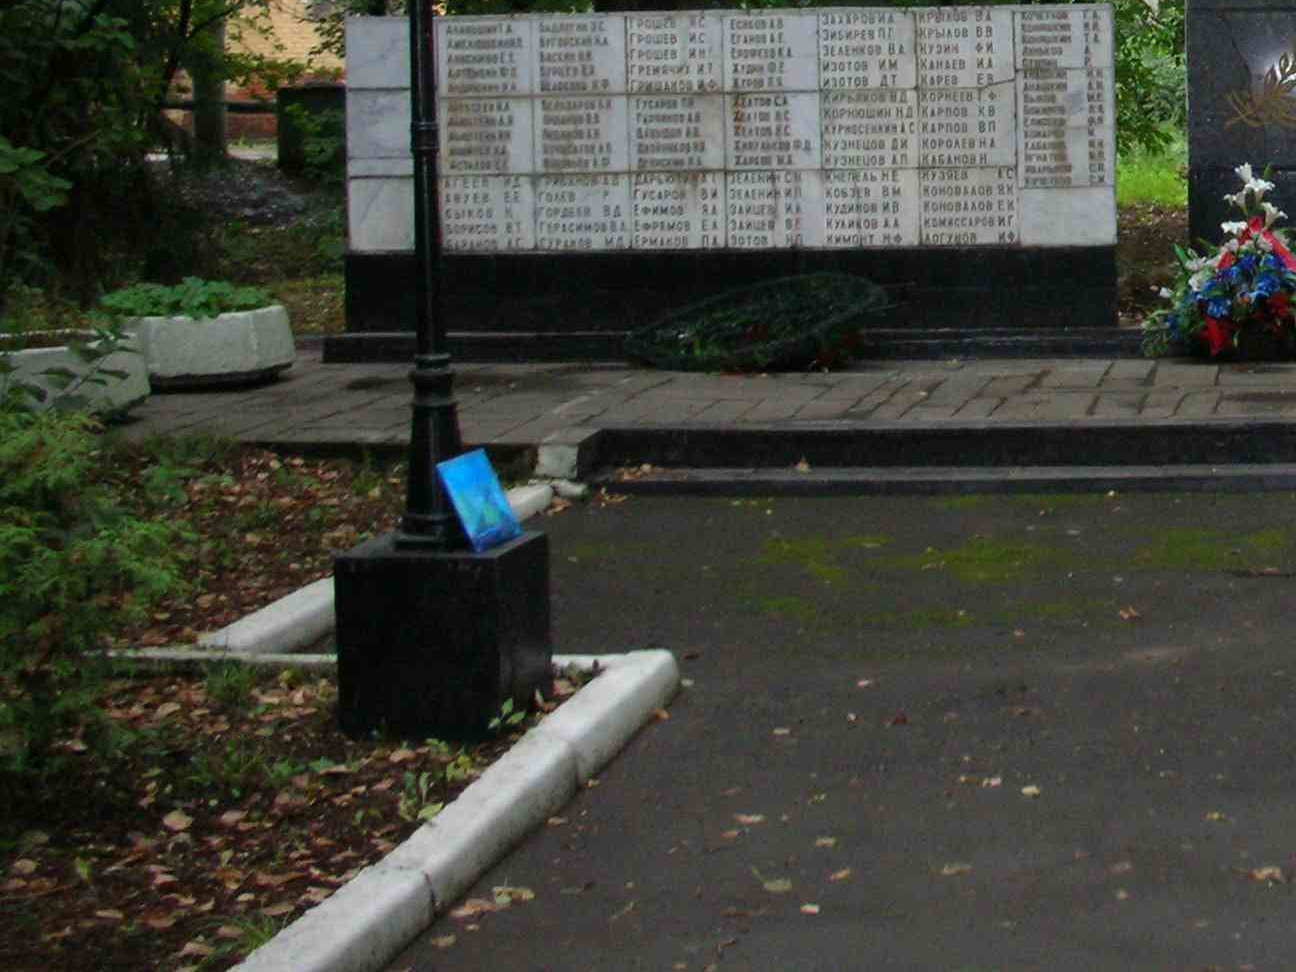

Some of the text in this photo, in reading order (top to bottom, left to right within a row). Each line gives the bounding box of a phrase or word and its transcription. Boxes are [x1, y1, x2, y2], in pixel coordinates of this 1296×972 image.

[630, 33, 677, 44] ГРОШЕВ
[919, 27, 969, 39] КРЫЛОВ
[630, 48, 678, 60] ГРОШЕВ
[823, 60, 869, 72] ИЗОТОВ
[919, 58, 967, 70] КАНАЕВ
[823, 76, 870, 88] ИЗОТОВ
[919, 74, 959, 86] КАРЕВ
[921, 107, 969, 119] КАРПОВ
[921, 123, 969, 135] КАРПОВ
[824, 139, 886, 151] КУЗНЕЦОВ
[921, 138, 976, 150] КОРОЛЕВ
[824, 155, 886, 167] КУЗНЕЦОВ
[921, 154, 977, 166] КАБАНОВ
[923, 185, 994, 197] КОНОВАЛОВ
[923, 201, 993, 213] КОНОВАЛОВ
[826, 218, 879, 230] КУЛИКОВ
[924, 217, 995, 229] КОМИССАРОВ
